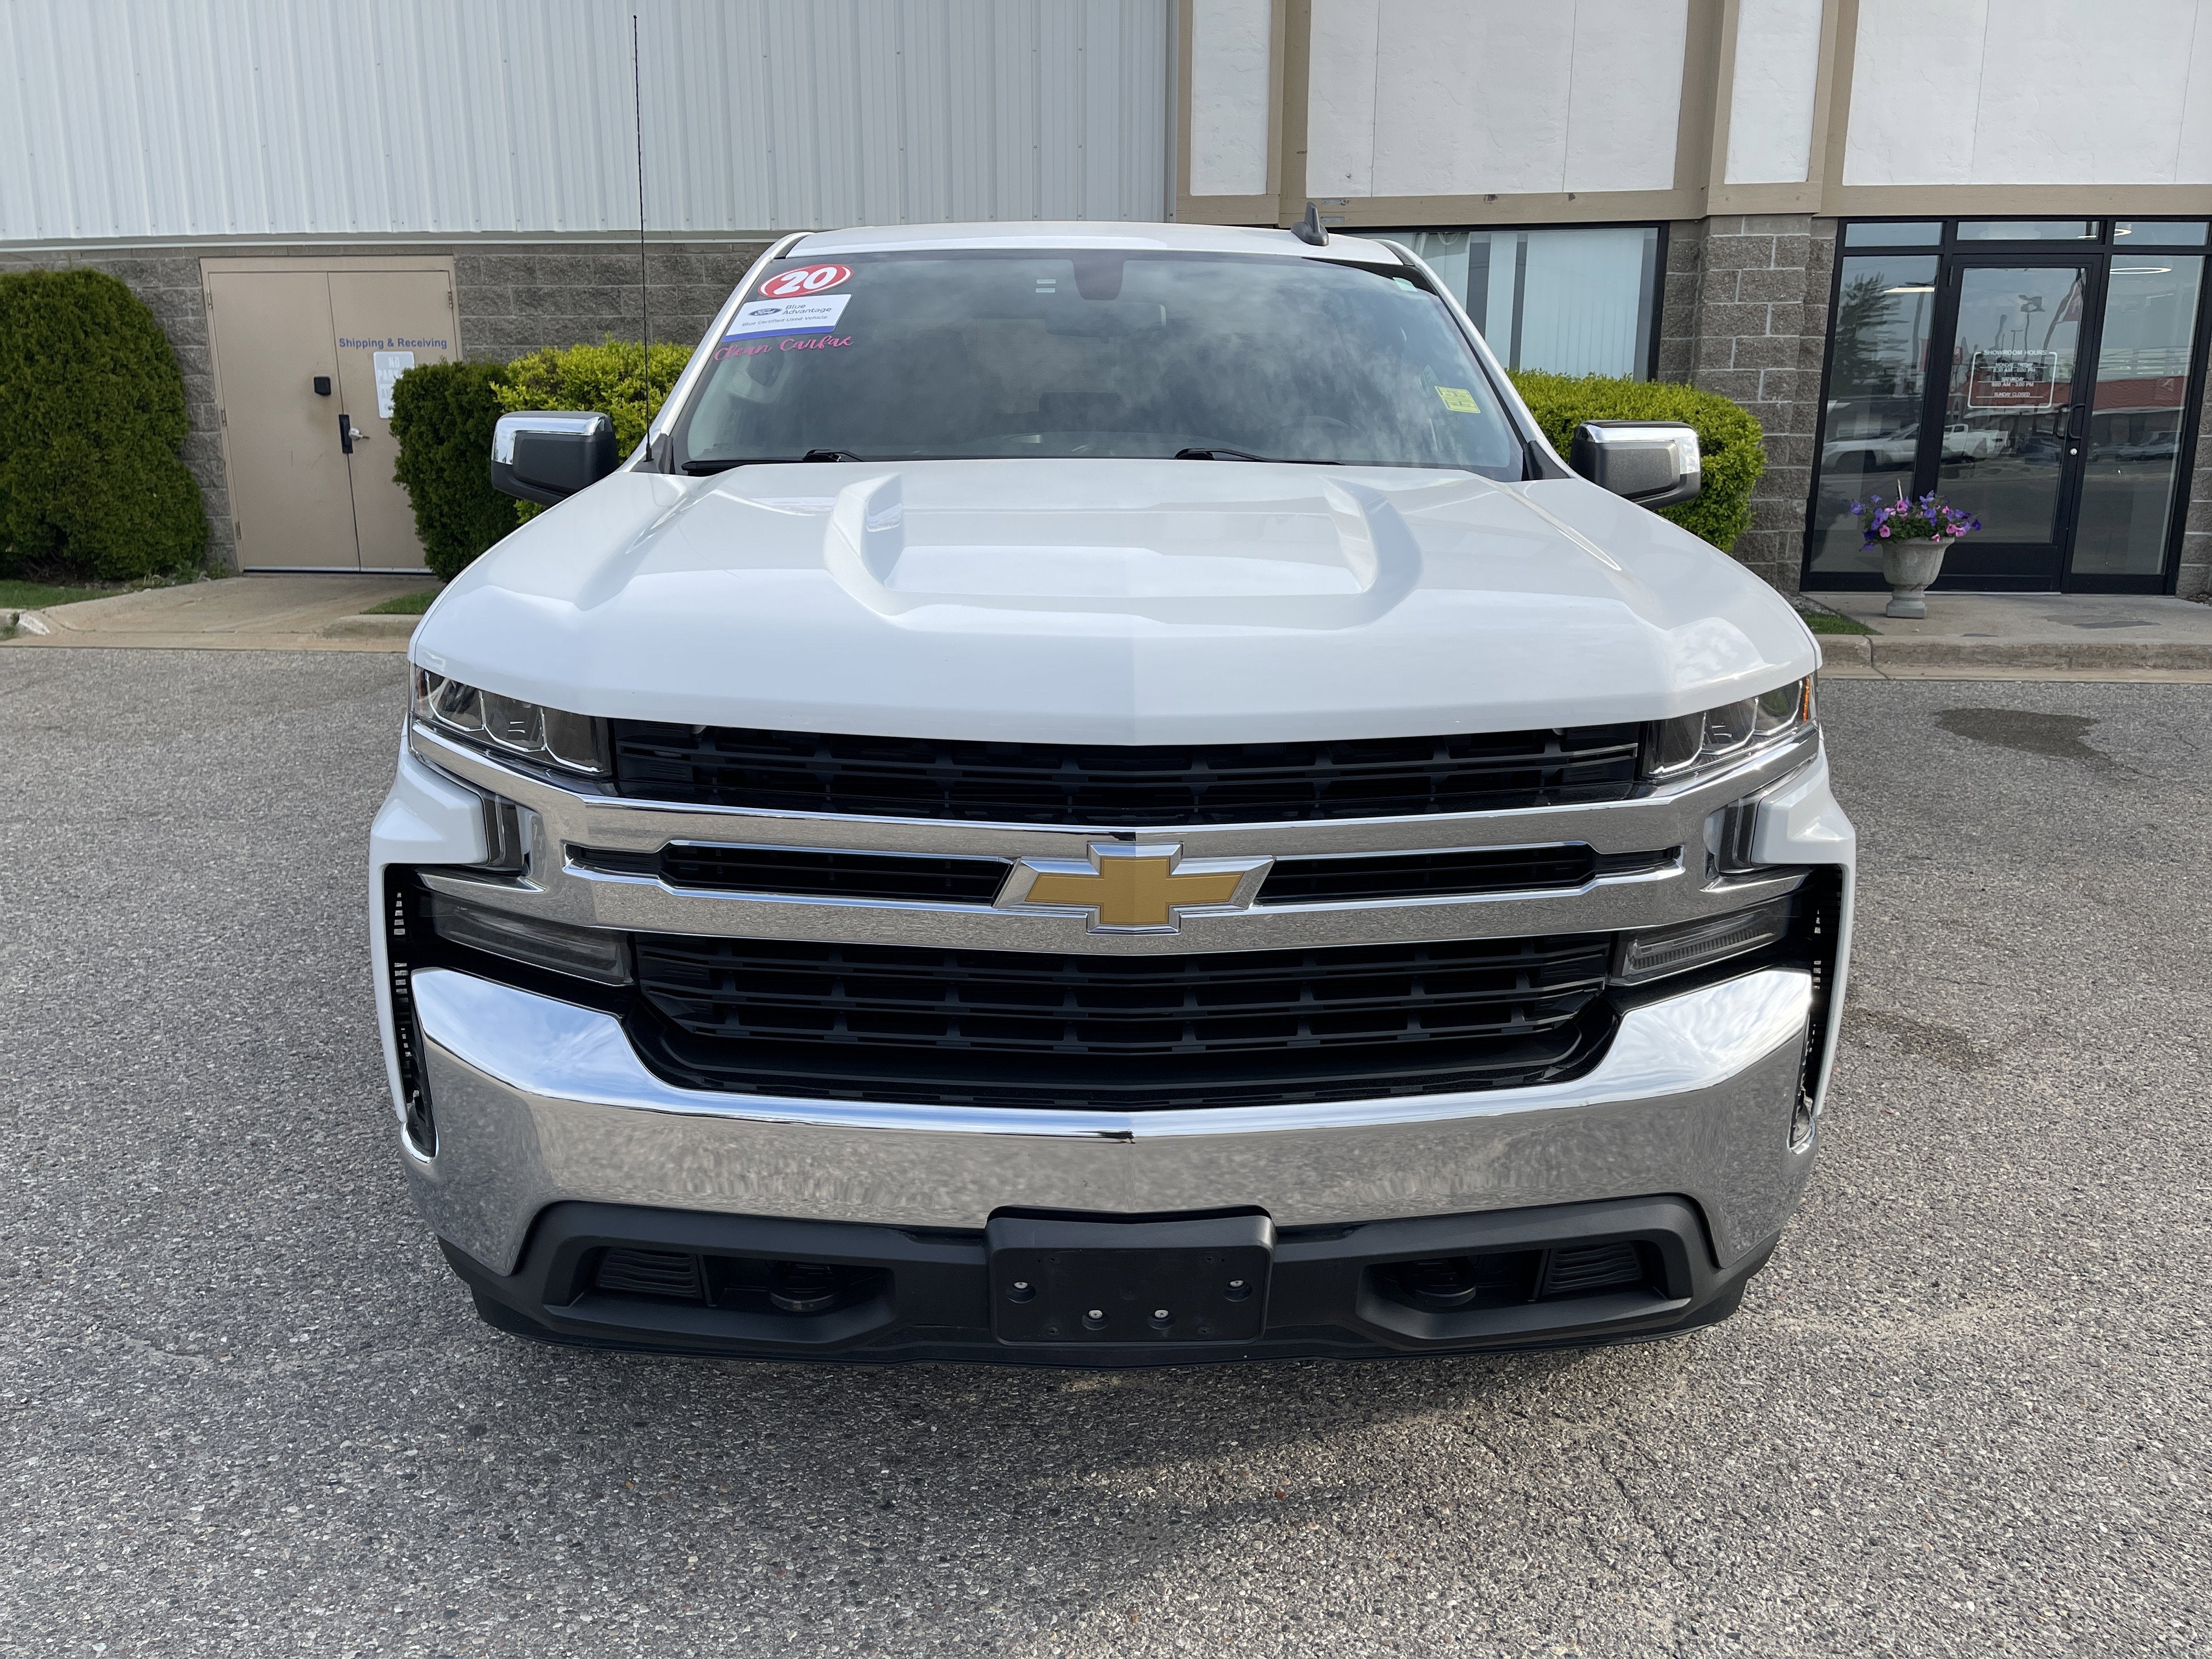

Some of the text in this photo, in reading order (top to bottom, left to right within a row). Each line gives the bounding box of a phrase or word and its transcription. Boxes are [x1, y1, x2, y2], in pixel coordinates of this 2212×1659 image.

[772, 267, 838, 295] 20
[782, 307, 832, 315] Advantage
[339, 338, 447, 349] Shipping & Receiving
[388, 357, 400, 368] NO
[377, 369, 403, 381] PARK
